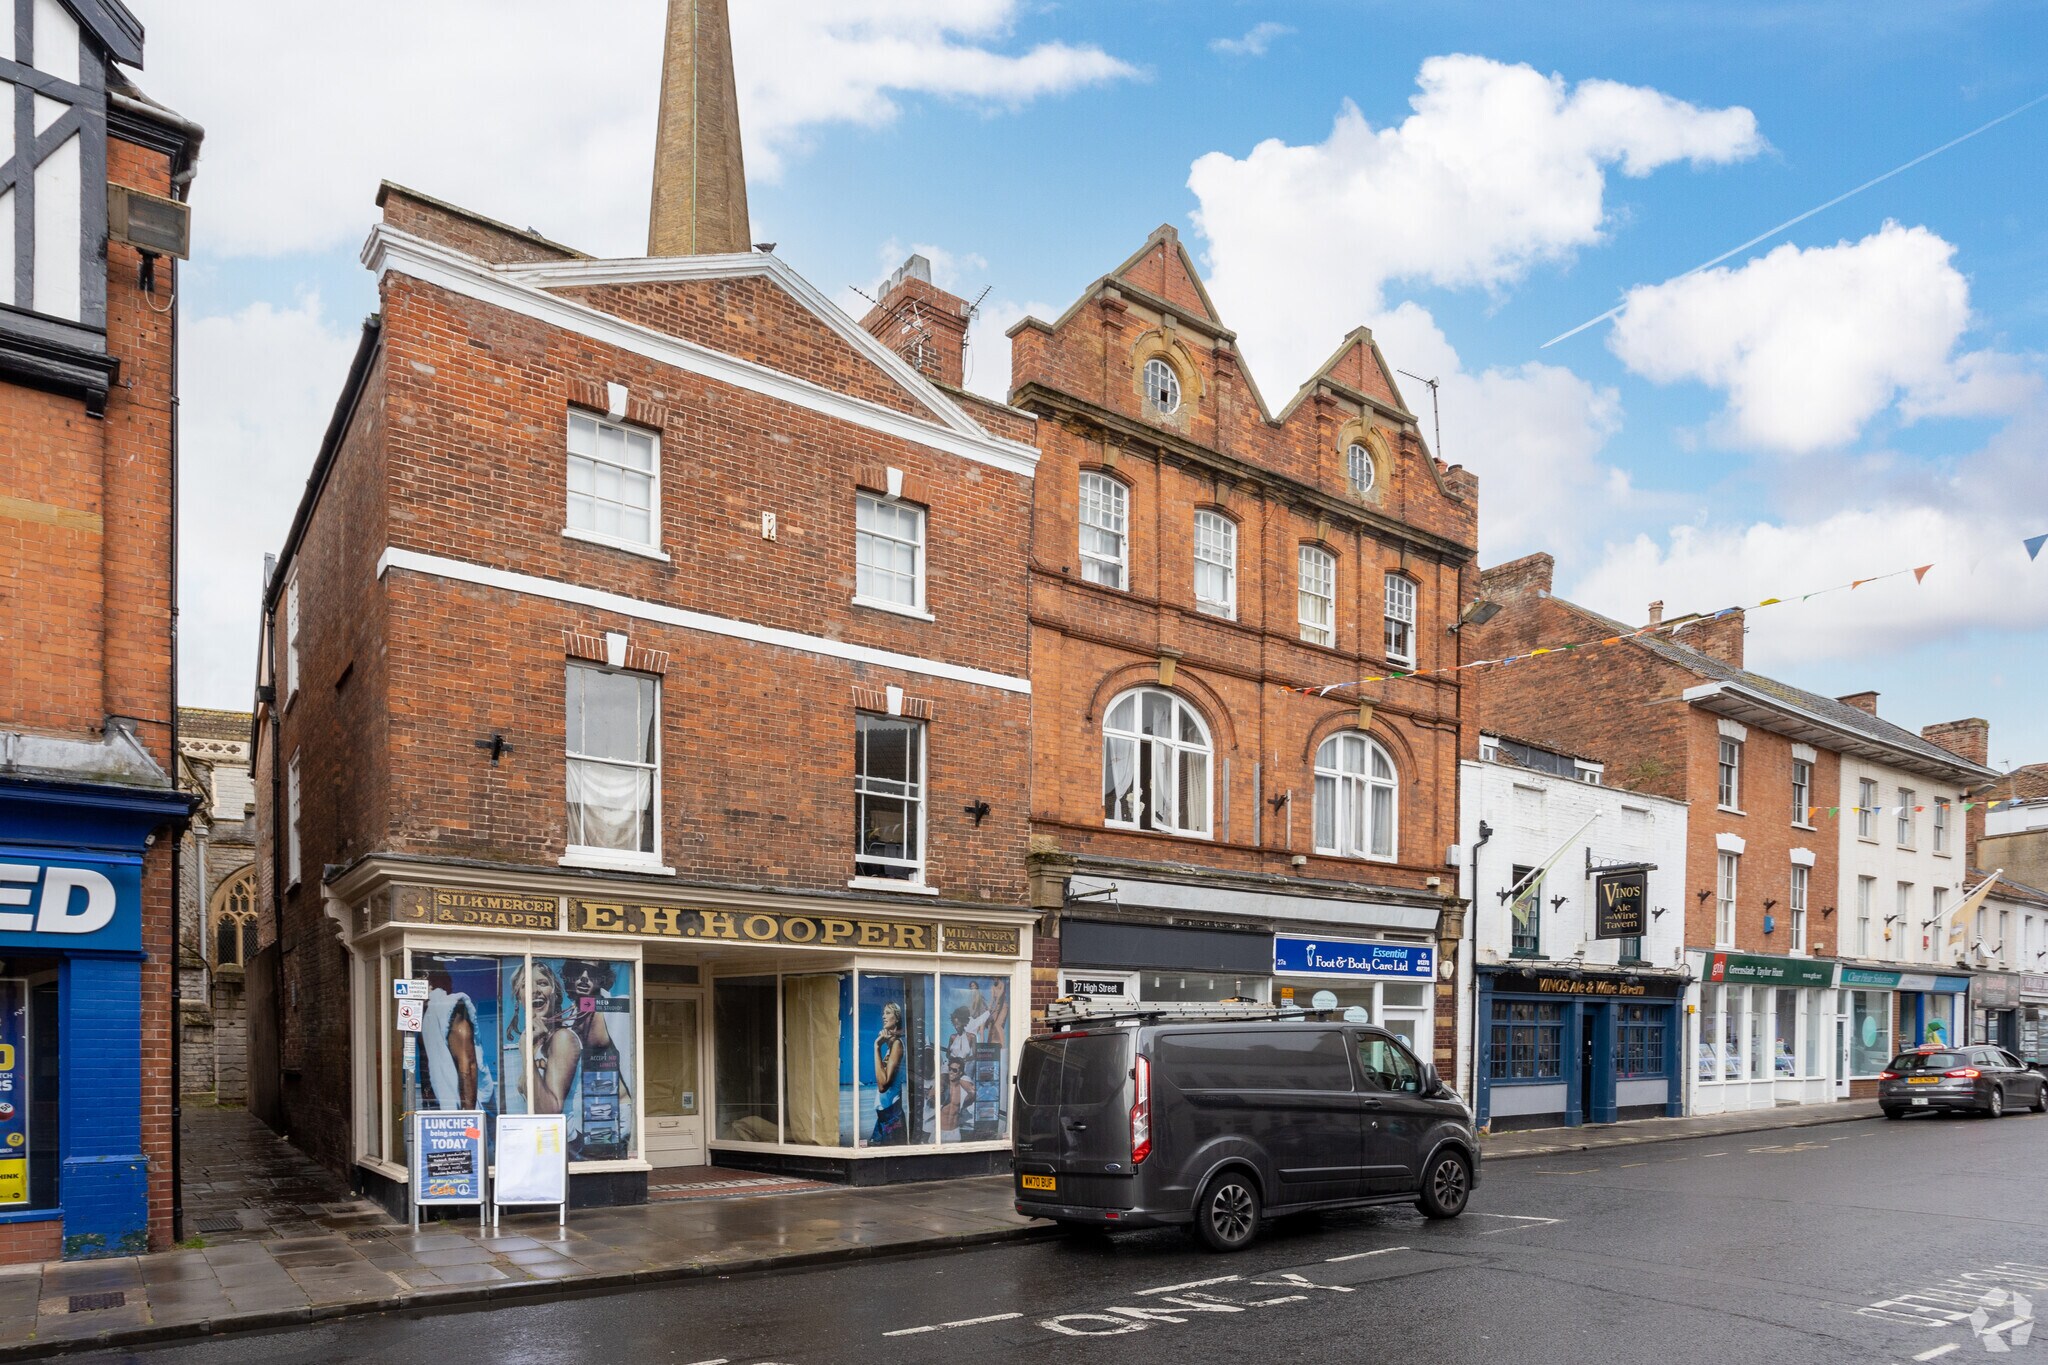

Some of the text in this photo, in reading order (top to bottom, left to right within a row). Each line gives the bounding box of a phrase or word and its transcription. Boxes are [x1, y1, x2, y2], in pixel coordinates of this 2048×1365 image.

[1603, 883, 1641, 907] VINO'S
[1615, 904, 1631, 912] Ale
[438, 909, 553, 928] & DRAPER
[1613, 912, 1638, 920] Wine
[1605, 921, 1637, 929] Tavern
[946, 941, 1017, 953] & MANTLES
[1373, 948, 1408, 959] Essential
[1316, 956, 1409, 972] Foot & Body Care Ltd
[1729, 965, 1755, 975] Greenslade
[1757, 967, 1771, 978] Taylor
[1771, 967, 1784, 977] Hunt
[1848, 972, 1861, 982] Clear
[1872, 974, 1894, 984] Solutions
[1083, 983, 1097, 994] High
[1098, 983, 1117, 993] Street
[1539, 978, 1645, 995] VINOS Ale & Wine Tavern
[425, 1118, 474, 1130] LUNCHES
[430, 1130, 448, 1138] being
[431, 1138, 468, 1149] TODAY
[1041, 1177, 1053, 1188] BUF
[1035, 1273, 1355, 1336] ONLY
